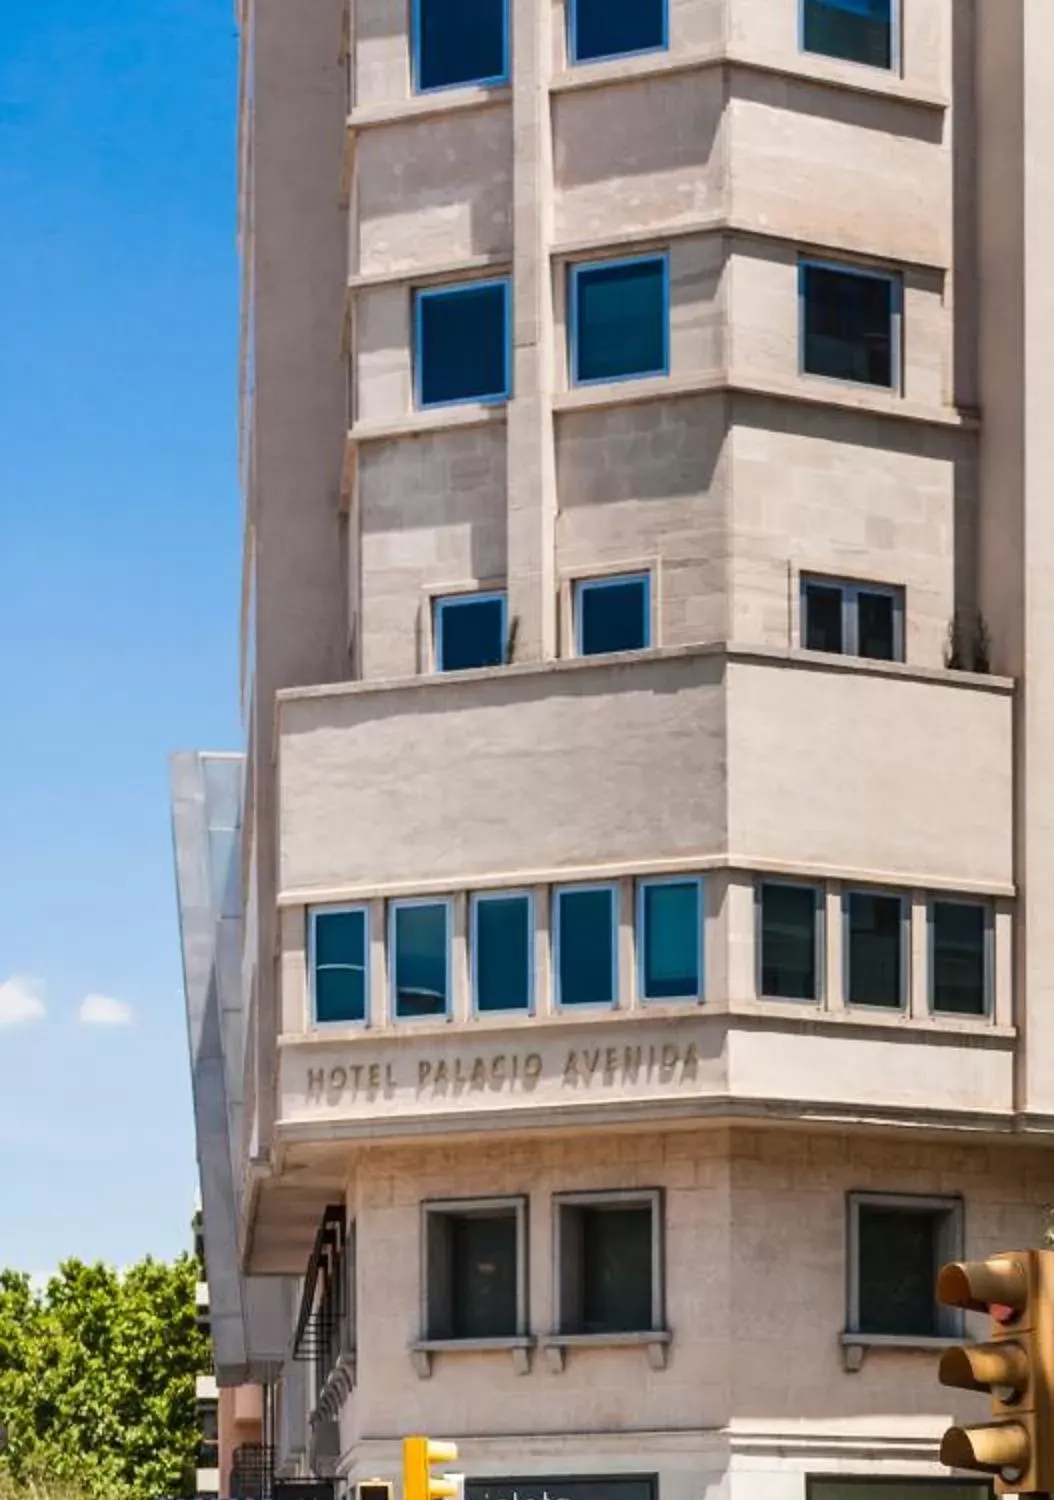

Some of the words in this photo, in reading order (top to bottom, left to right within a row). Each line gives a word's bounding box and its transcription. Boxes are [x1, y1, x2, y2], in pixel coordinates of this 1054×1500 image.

[306, 1062, 398, 1091] HOTEL
[417, 1052, 543, 1086] PALACIO
[563, 1040, 698, 1074] AVENIDA
